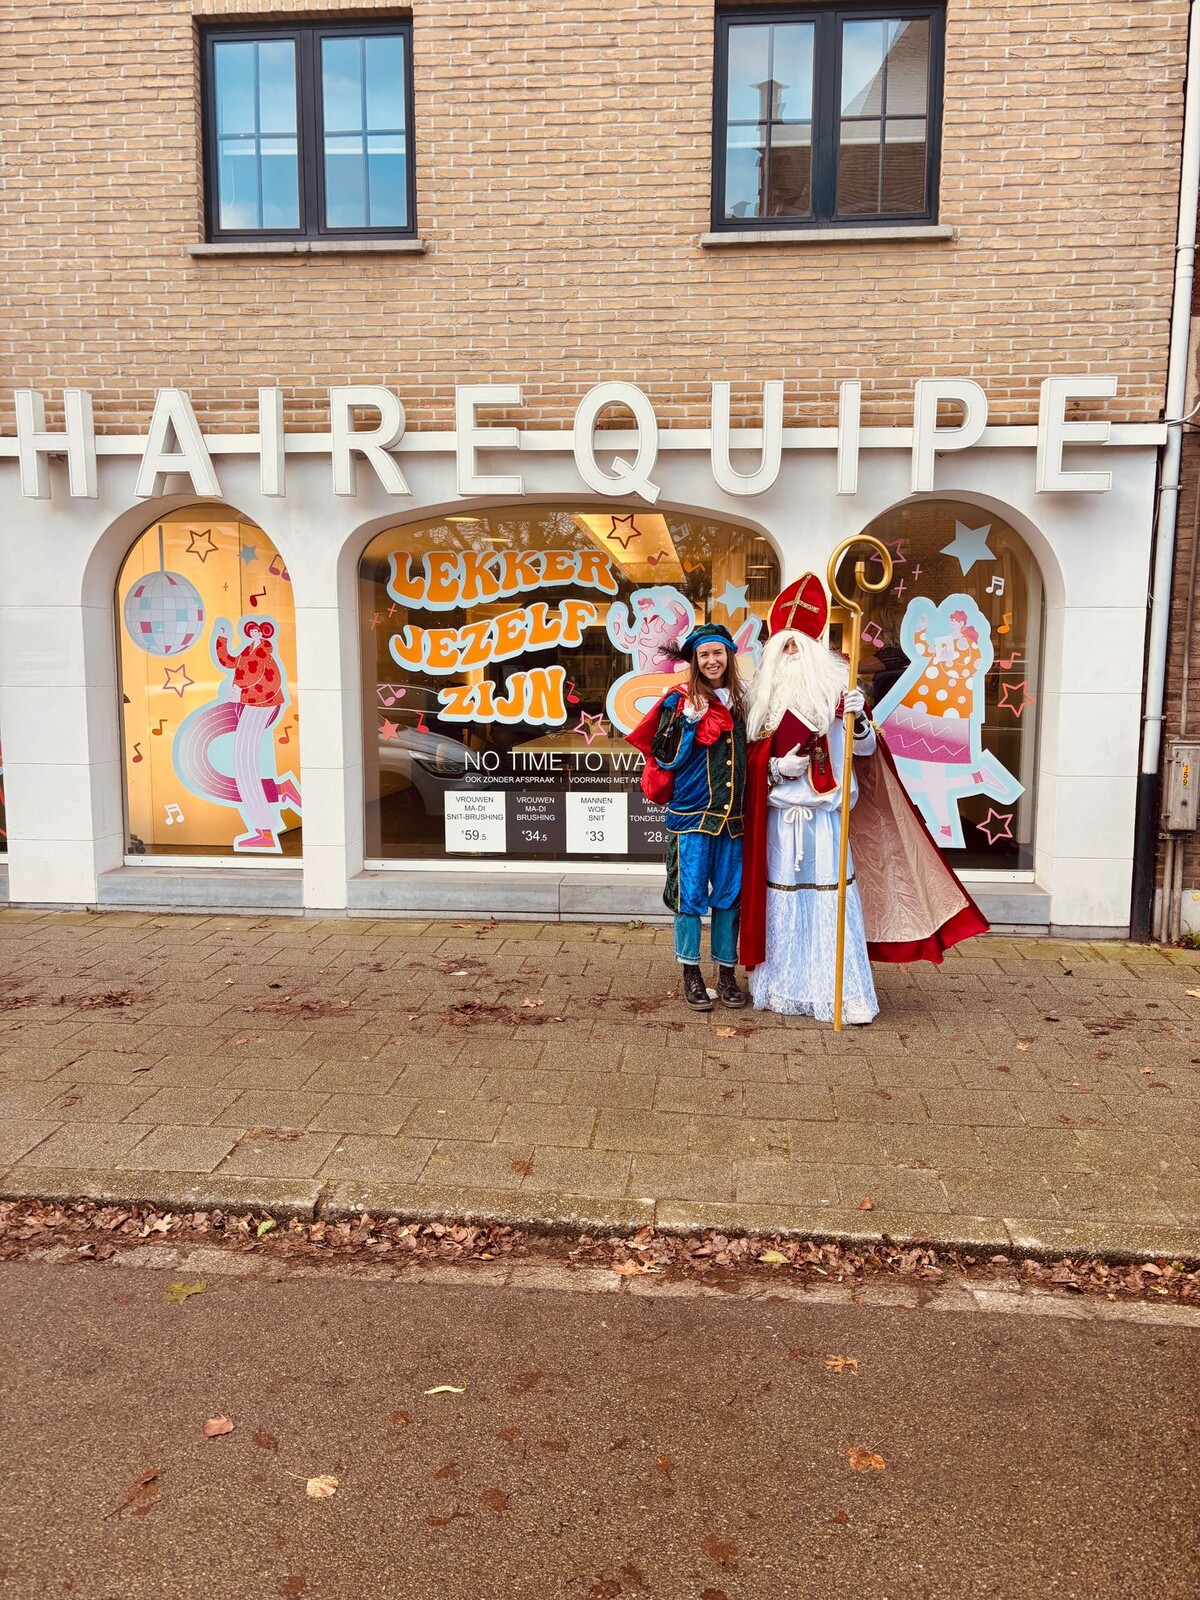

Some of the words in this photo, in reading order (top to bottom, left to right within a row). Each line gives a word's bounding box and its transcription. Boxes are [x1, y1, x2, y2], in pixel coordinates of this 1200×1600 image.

[388, 550, 618, 610] LEKKER
[390, 599, 597, 674] JEZELF
[438, 665, 567, 726] ZIJN
[464, 750, 500, 771] NO
[507, 750, 564, 771] TIME
[570, 751, 603, 771] TO
[611, 751, 647, 771] WA
[465, 776, 482, 784] OOK
[483, 776, 515, 784] ZONDER
[515, 776, 555, 784] AFSPRAAK
[569, 776, 612, 784] VOORRANG
[613, 776, 630, 784] MET
[446, 813, 504, 821] SNIT-BRUSHING
[629, 814, 667, 822] TONDEUS
